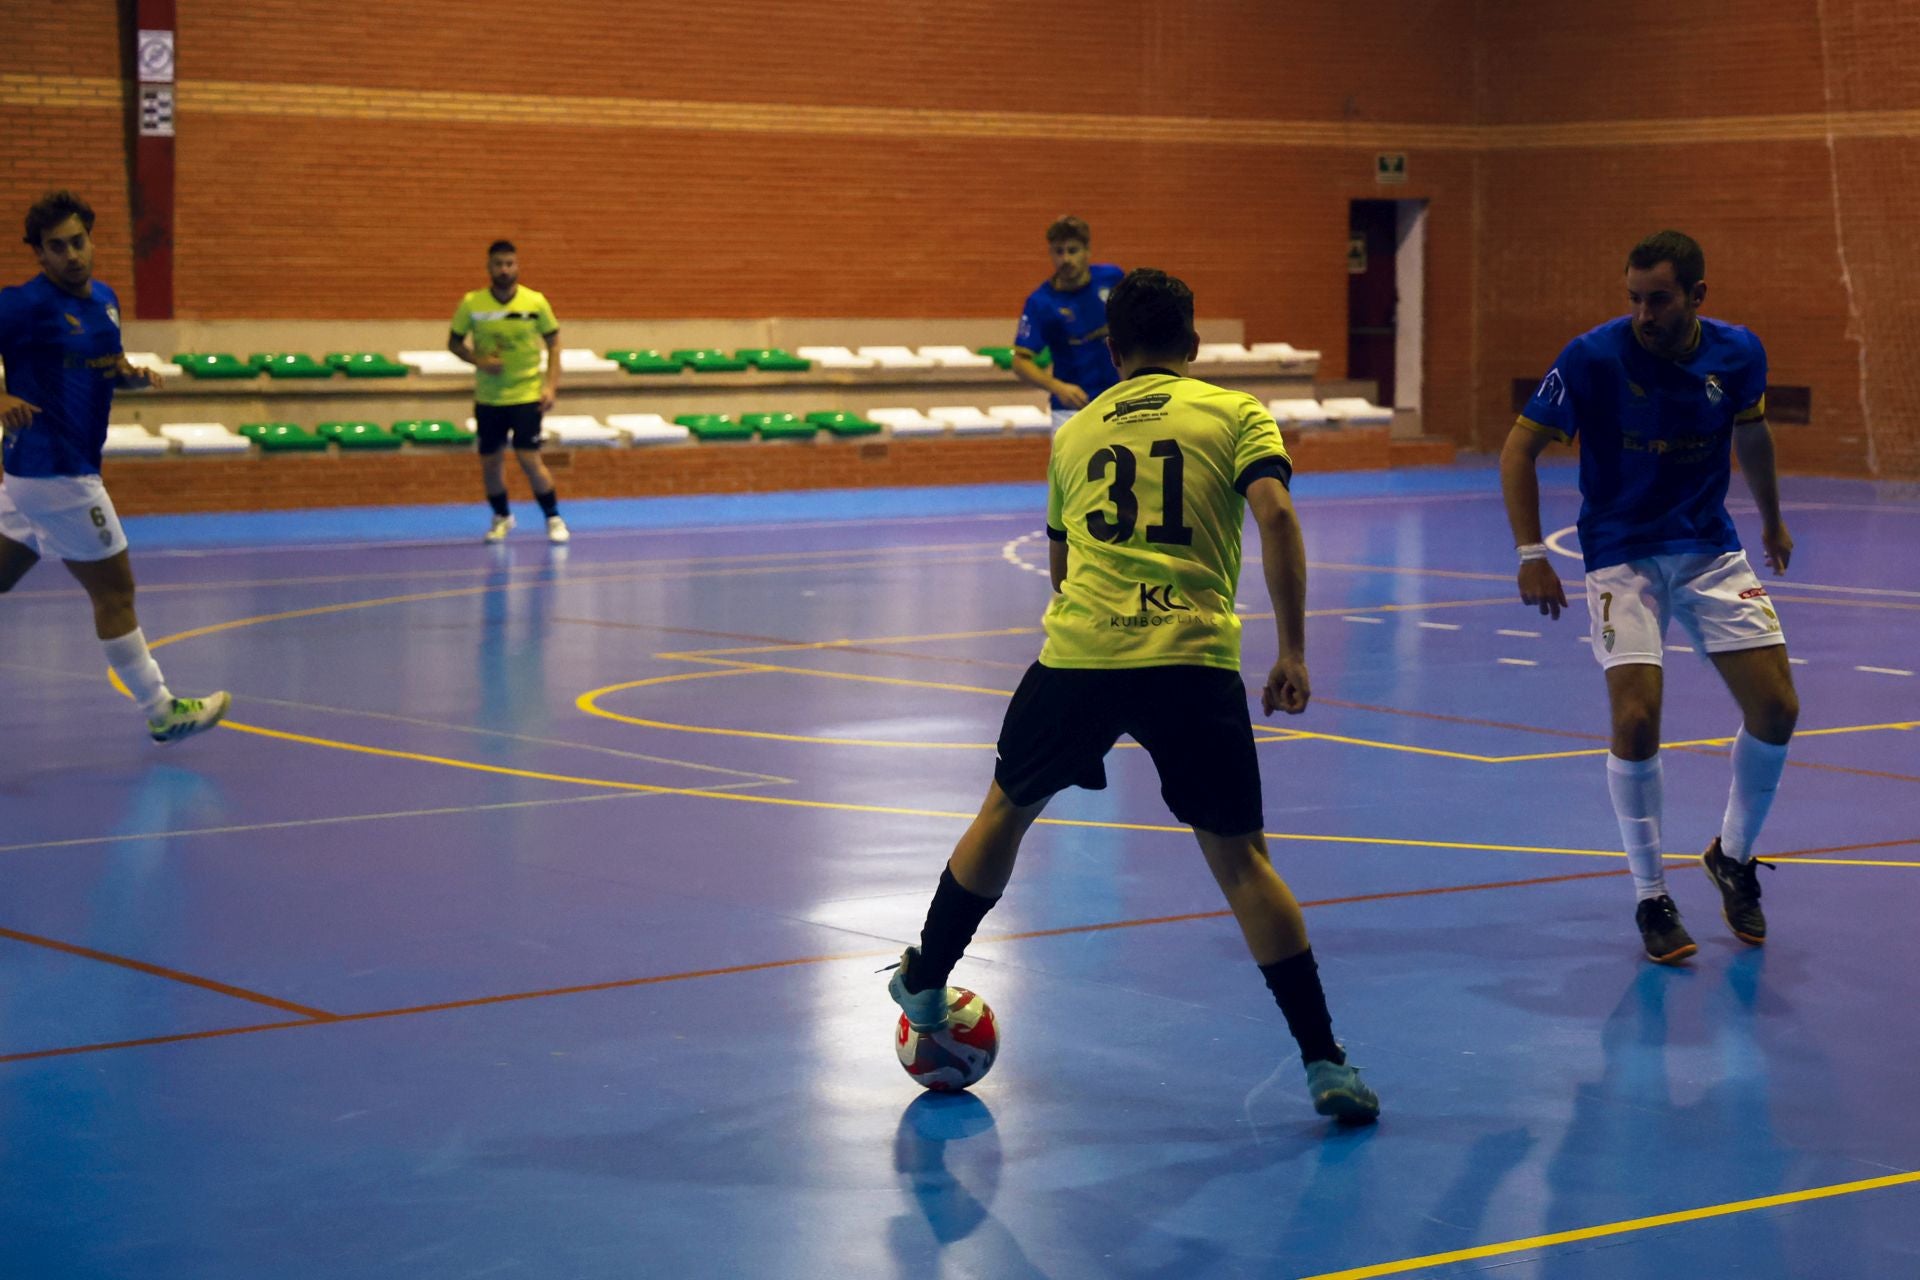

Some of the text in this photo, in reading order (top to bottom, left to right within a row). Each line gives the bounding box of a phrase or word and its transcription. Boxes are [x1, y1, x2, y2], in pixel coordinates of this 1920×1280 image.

[1085, 438, 1193, 546] 31
[90, 505, 106, 528] 6
[1140, 582, 1191, 612] KC
[1600, 591, 1613, 622] 7
